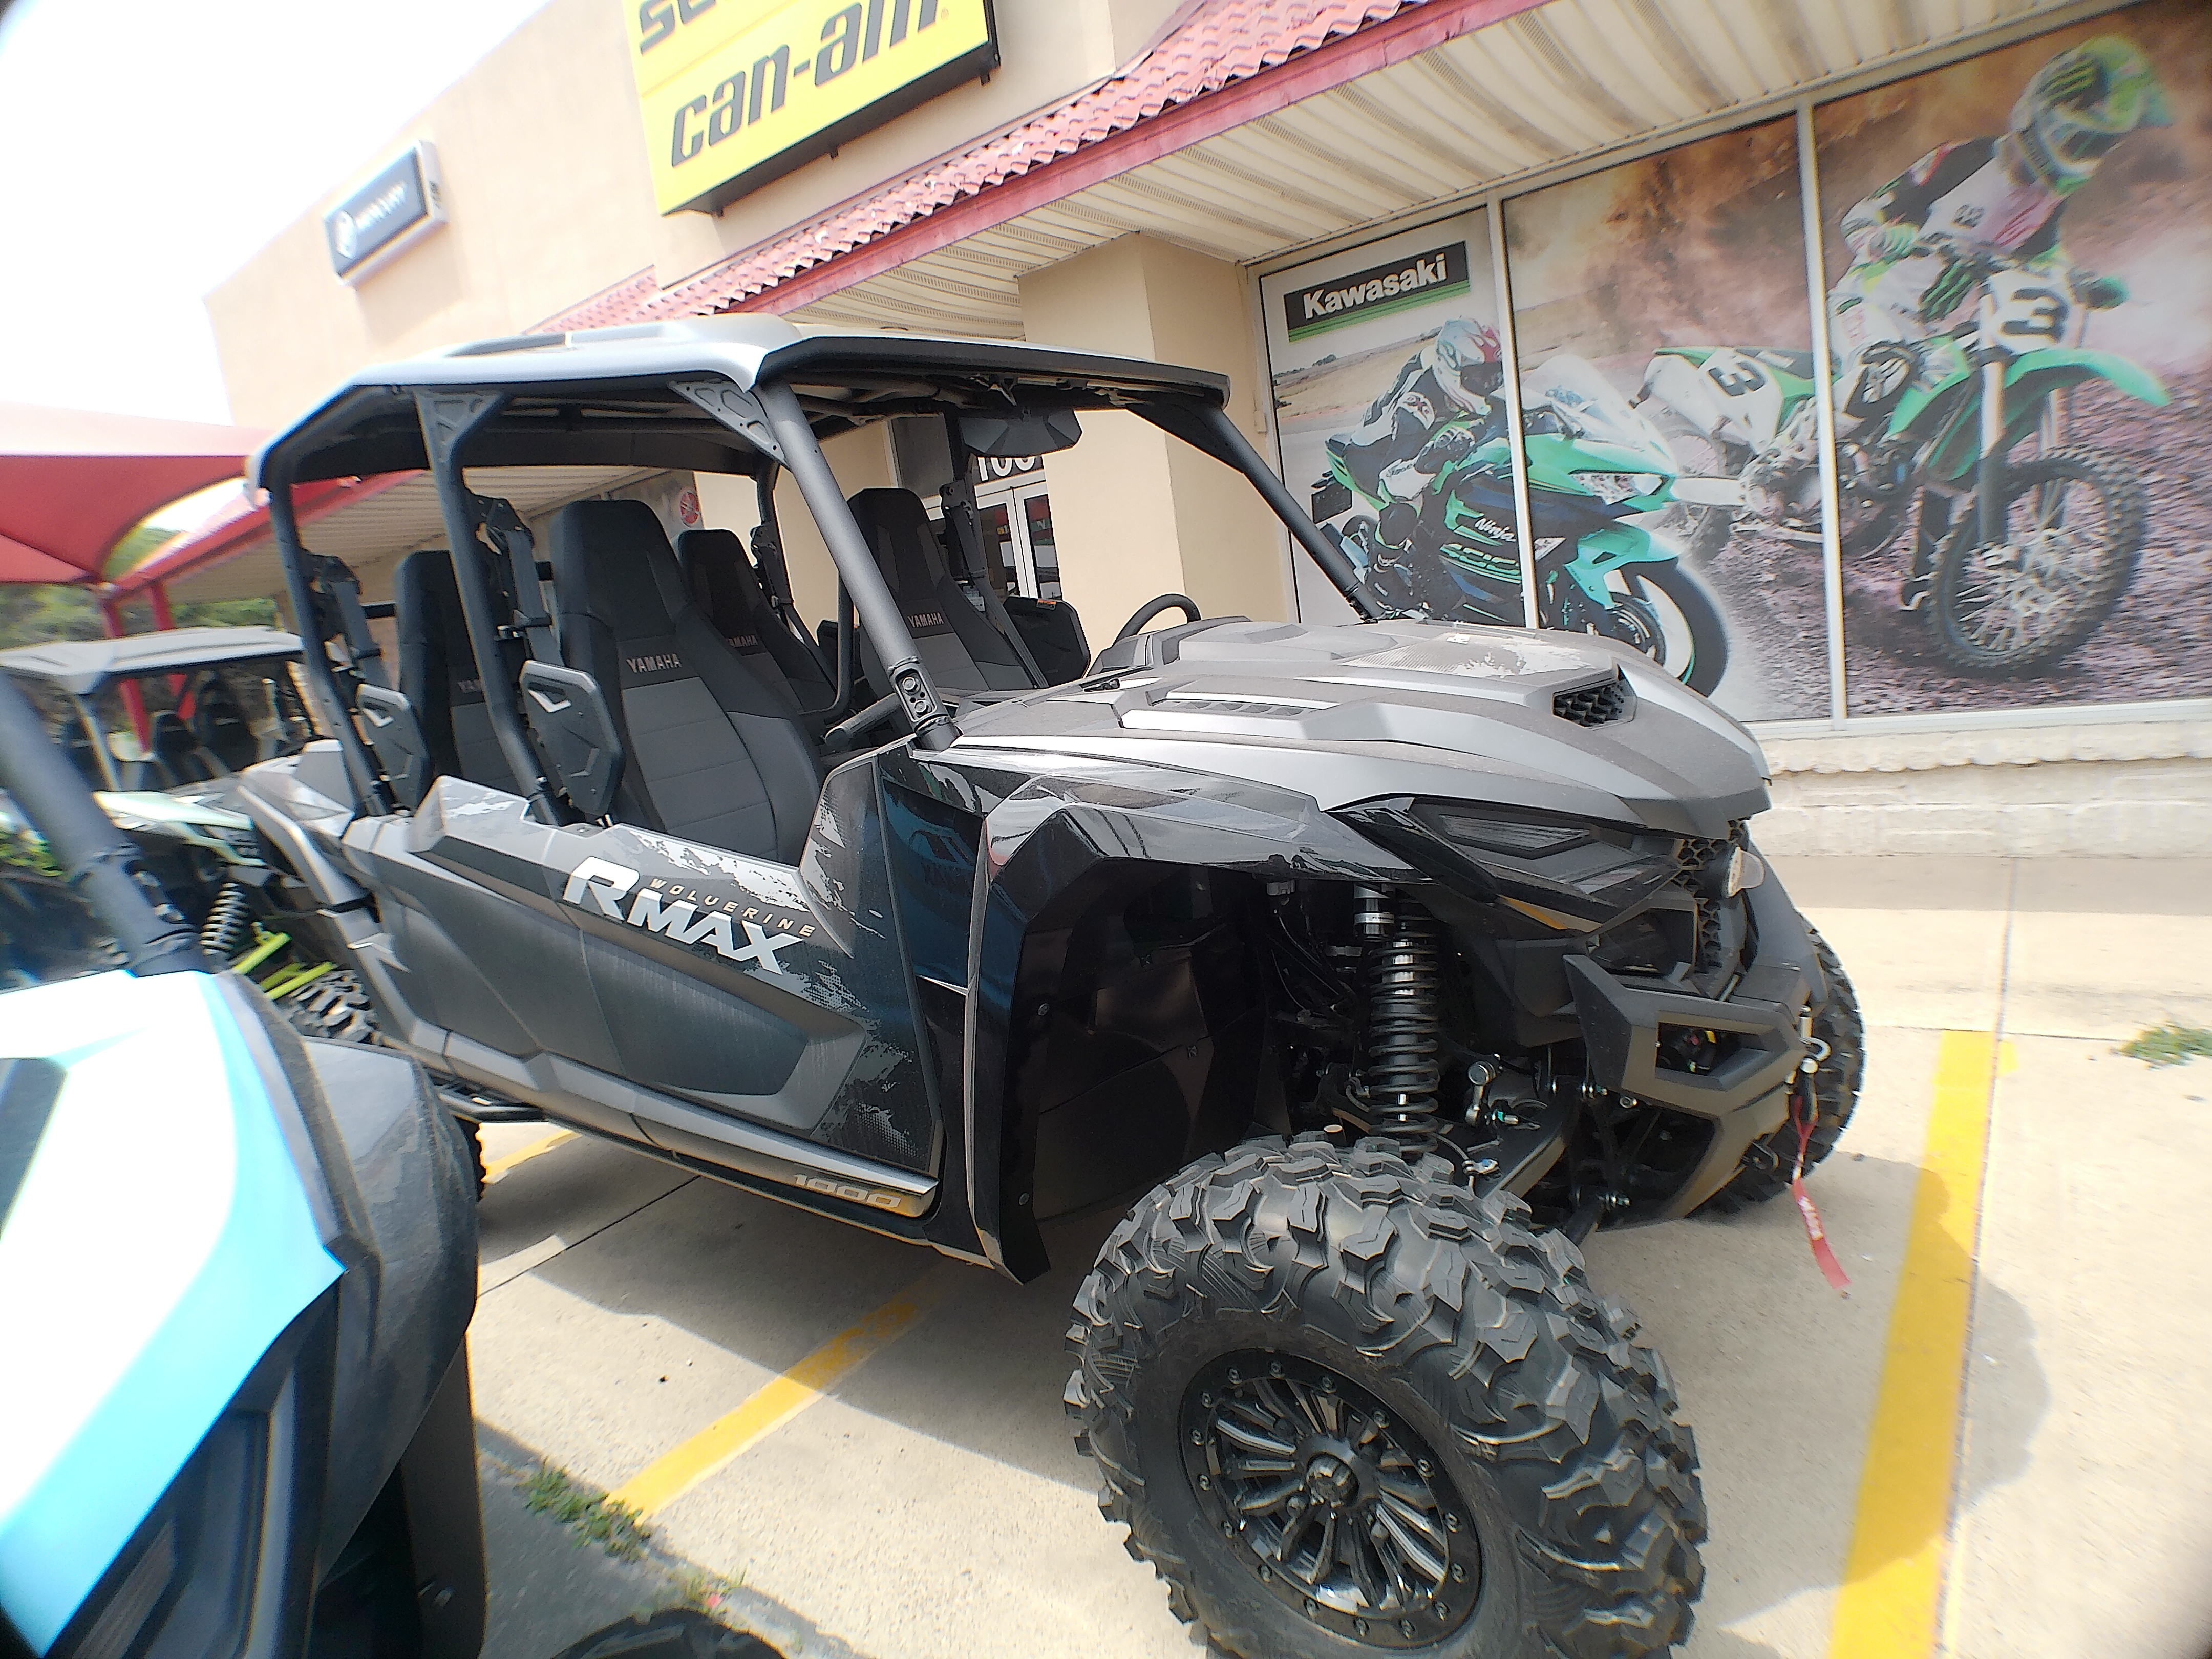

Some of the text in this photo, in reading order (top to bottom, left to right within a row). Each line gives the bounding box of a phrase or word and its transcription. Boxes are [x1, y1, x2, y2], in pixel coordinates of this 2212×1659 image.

[1302, 253, 1448, 320] Kawasaki
[1474, 518, 1517, 542] Ninja
[907, 612, 944, 628] YAMAHA
[727, 635, 758, 647] AMAHA
[626, 653, 682, 673] YAMAHA
[563, 856, 804, 975] RMAX
[649, 877, 816, 938] WOLVERINE
[793, 1174, 902, 1209] 1000
